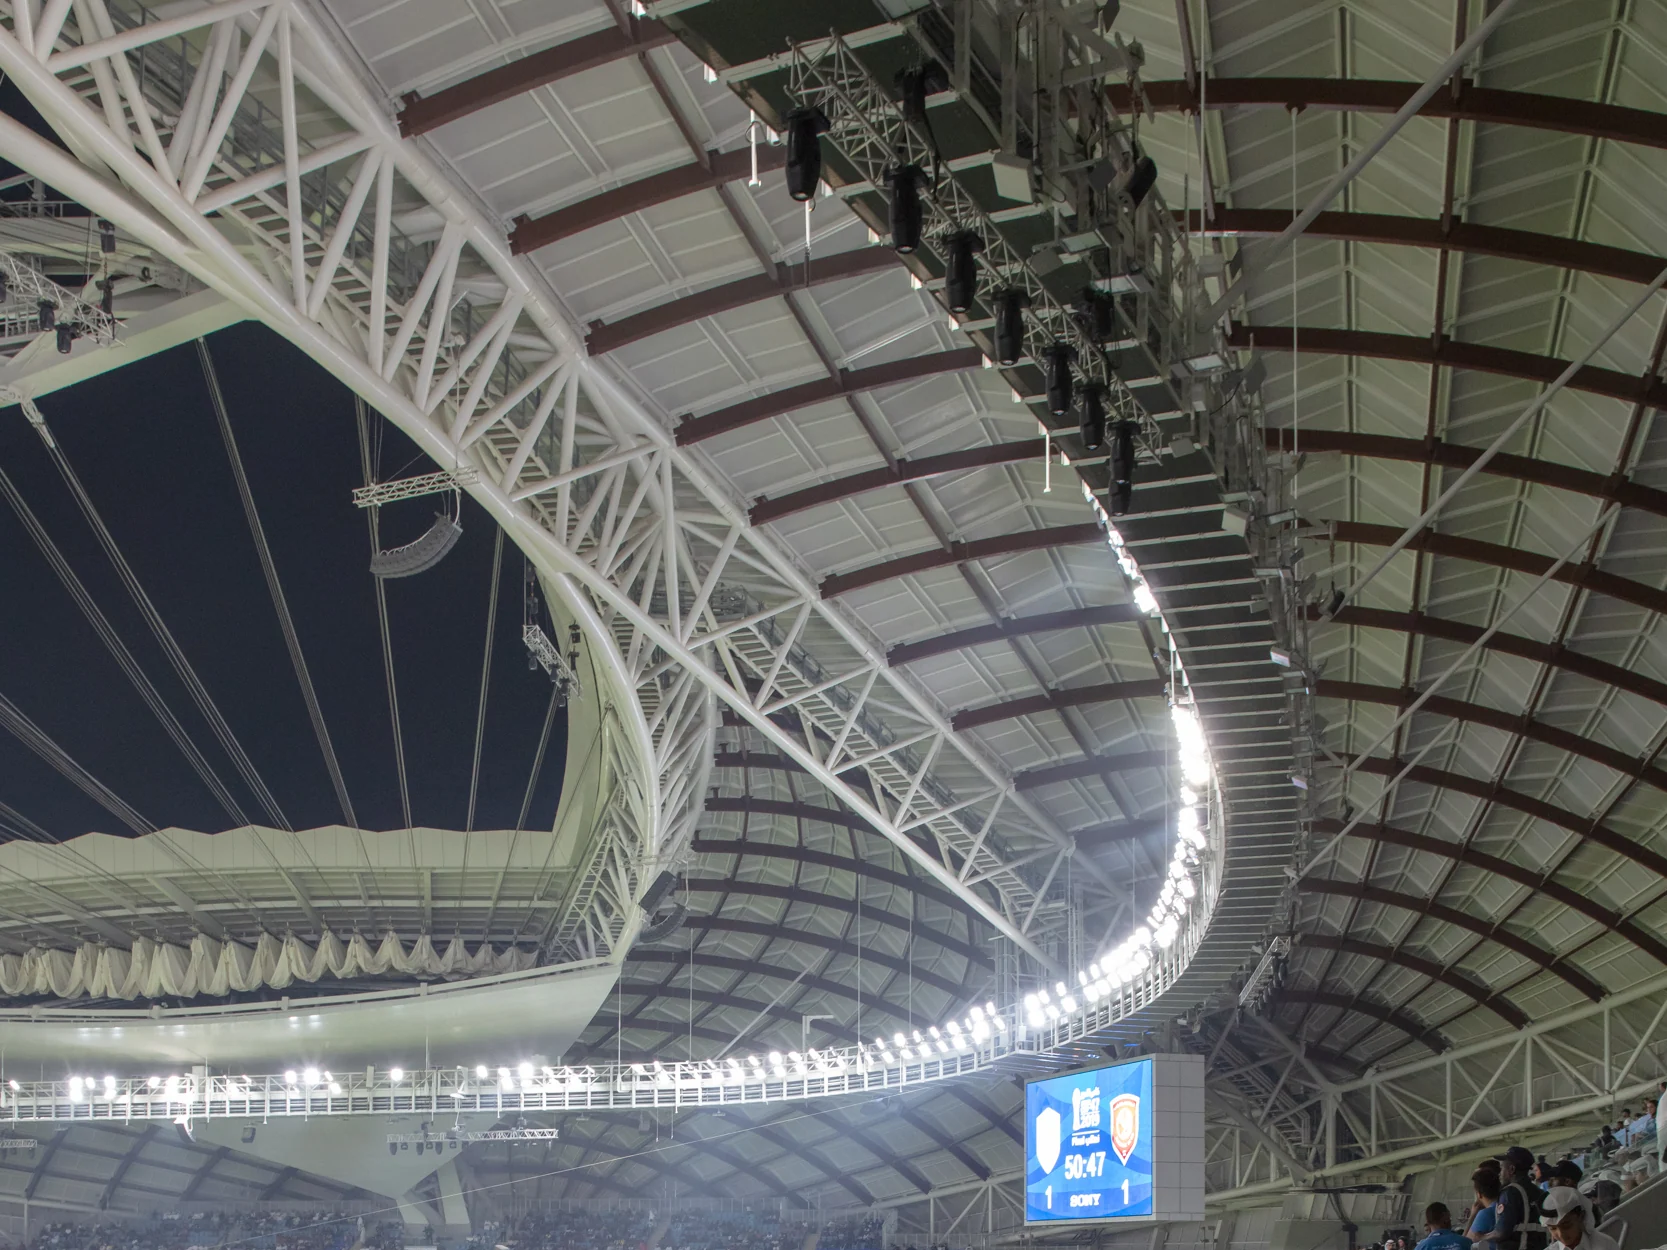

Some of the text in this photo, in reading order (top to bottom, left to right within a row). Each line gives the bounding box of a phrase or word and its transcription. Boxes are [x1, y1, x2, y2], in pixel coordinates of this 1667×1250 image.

[1064, 1151, 1106, 1180] 50:47
[1045, 1185, 1053, 1210] 1
[1070, 1193, 1101, 1208] SONY
[1120, 1178, 1129, 1204] 1
